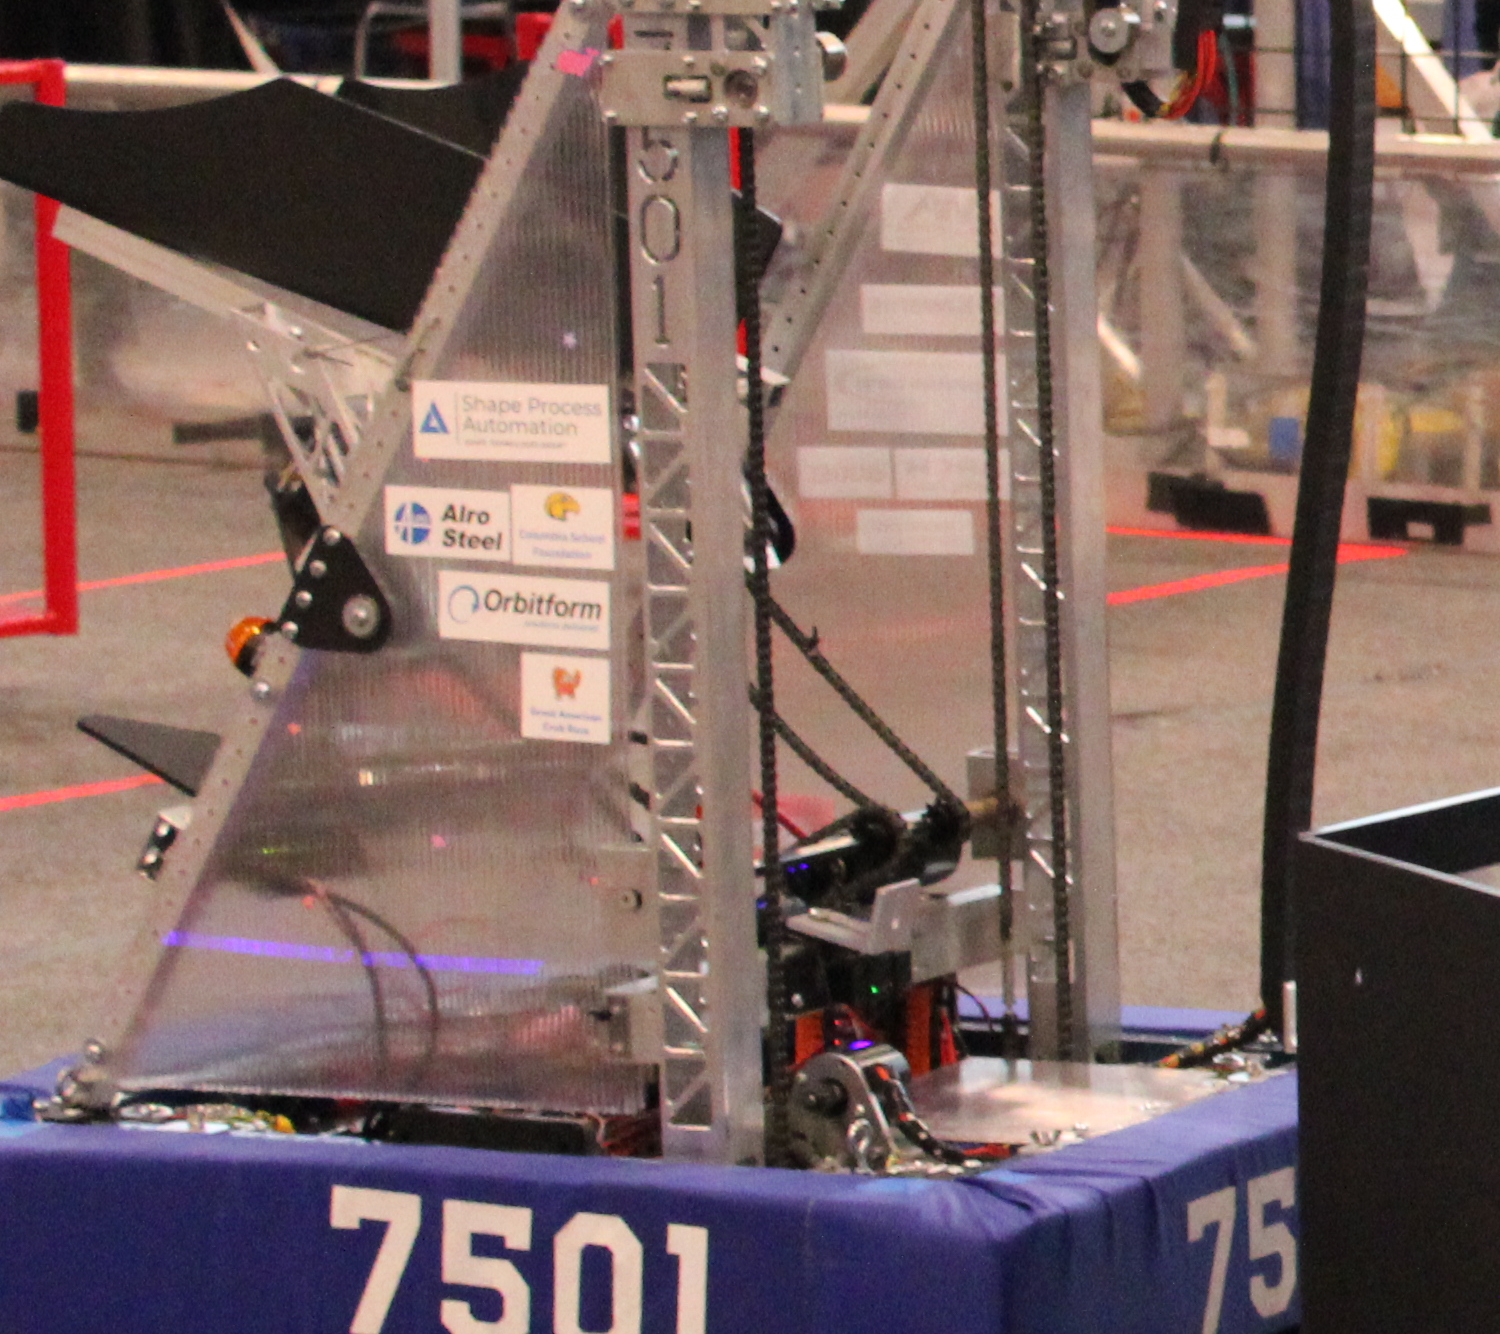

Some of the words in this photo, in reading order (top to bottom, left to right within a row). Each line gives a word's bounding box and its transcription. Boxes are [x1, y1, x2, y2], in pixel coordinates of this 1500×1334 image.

[462, 395, 520, 414] Shape
[528, 397, 602, 417] Process
[462, 416, 578, 436] Automation
[441, 503, 490, 525] Alro
[442, 528, 503, 551] Steel
[484, 588, 602, 620] Orbitform
